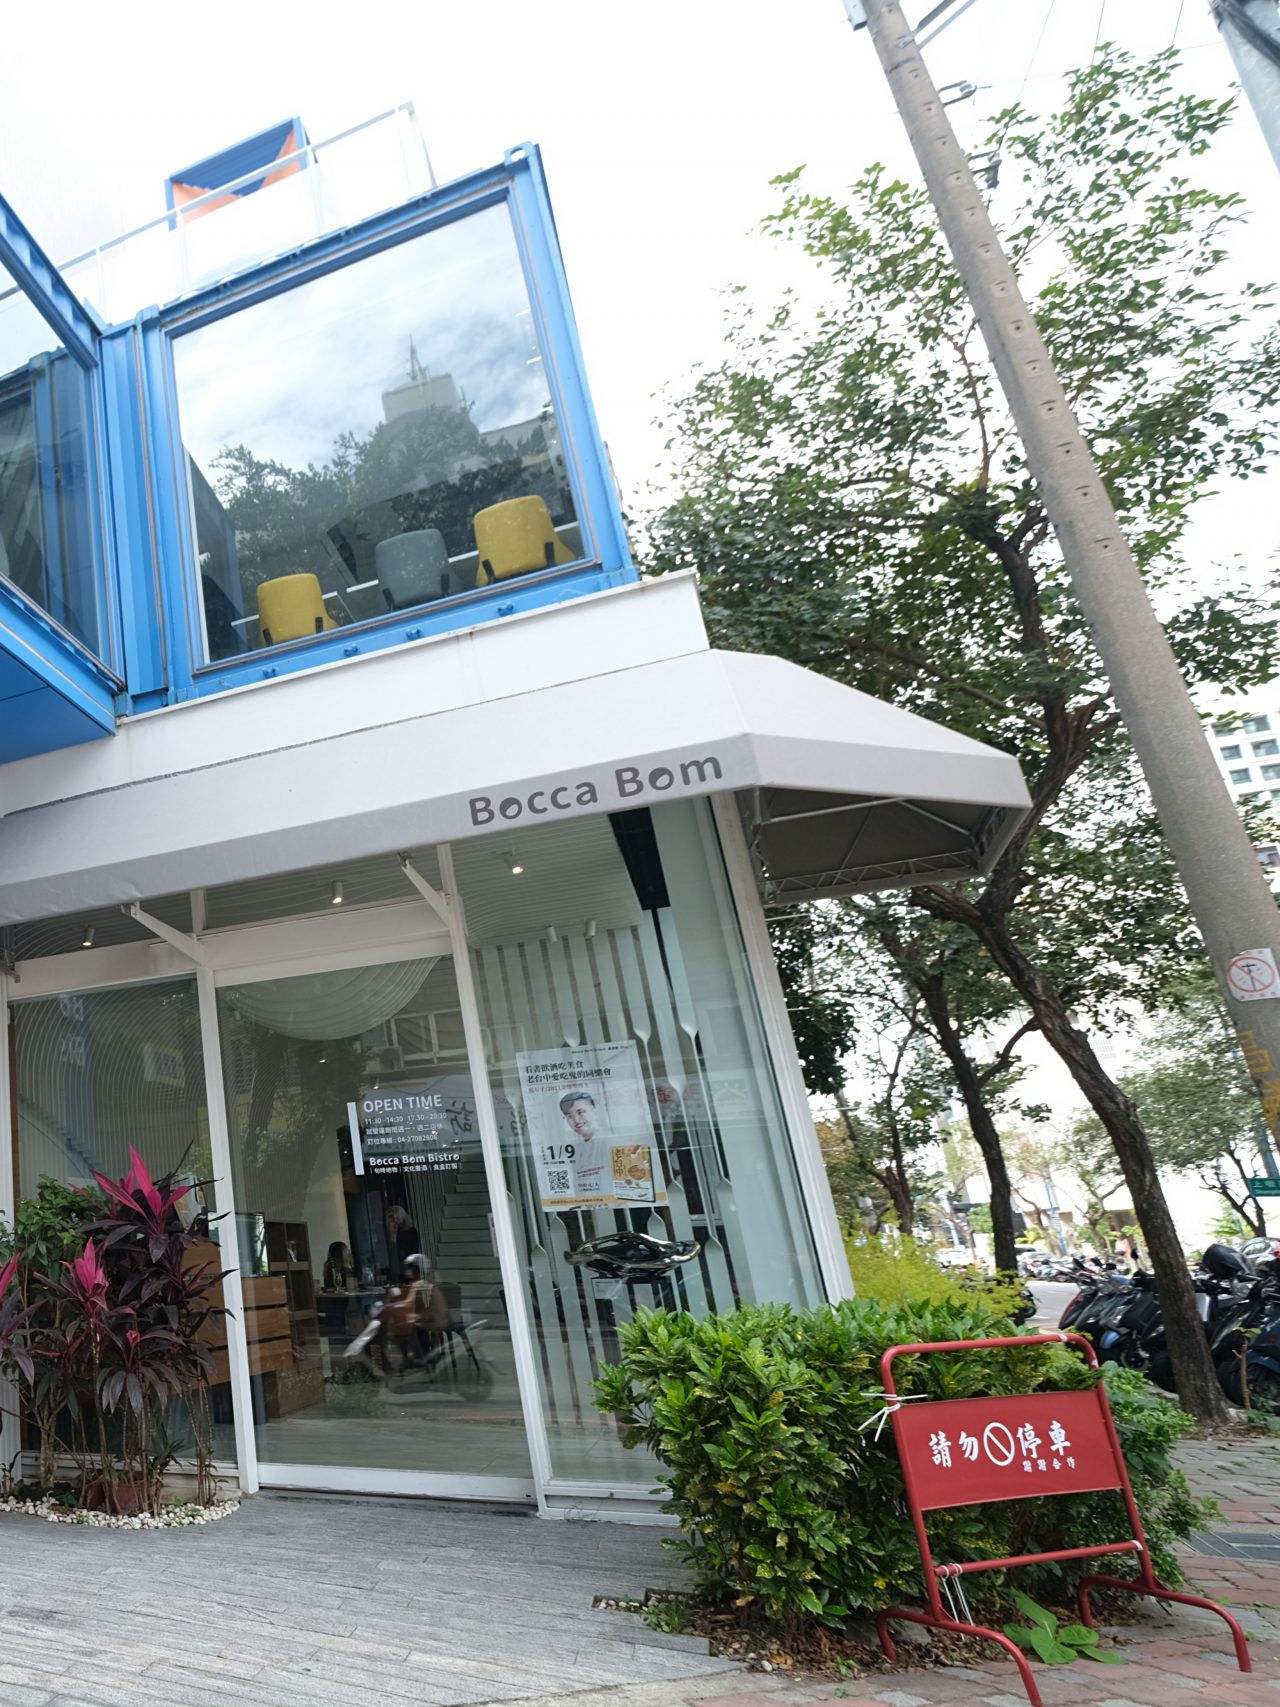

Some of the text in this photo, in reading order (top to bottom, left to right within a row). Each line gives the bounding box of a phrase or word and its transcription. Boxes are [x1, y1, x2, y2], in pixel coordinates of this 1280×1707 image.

[470, 756, 723, 827] Bocca Bom
[363, 1095, 443, 1113] OPEN TIME
[365, 1117, 382, 1125] 11:30
[369, 1153, 460, 1167] Bocca Bom Bistro
[546, 1144, 575, 1160] 1/9
[928, 1420, 1071, 1468] 請勿 停車
[1022, 1456, 1076, 1472] 謝謝合作
